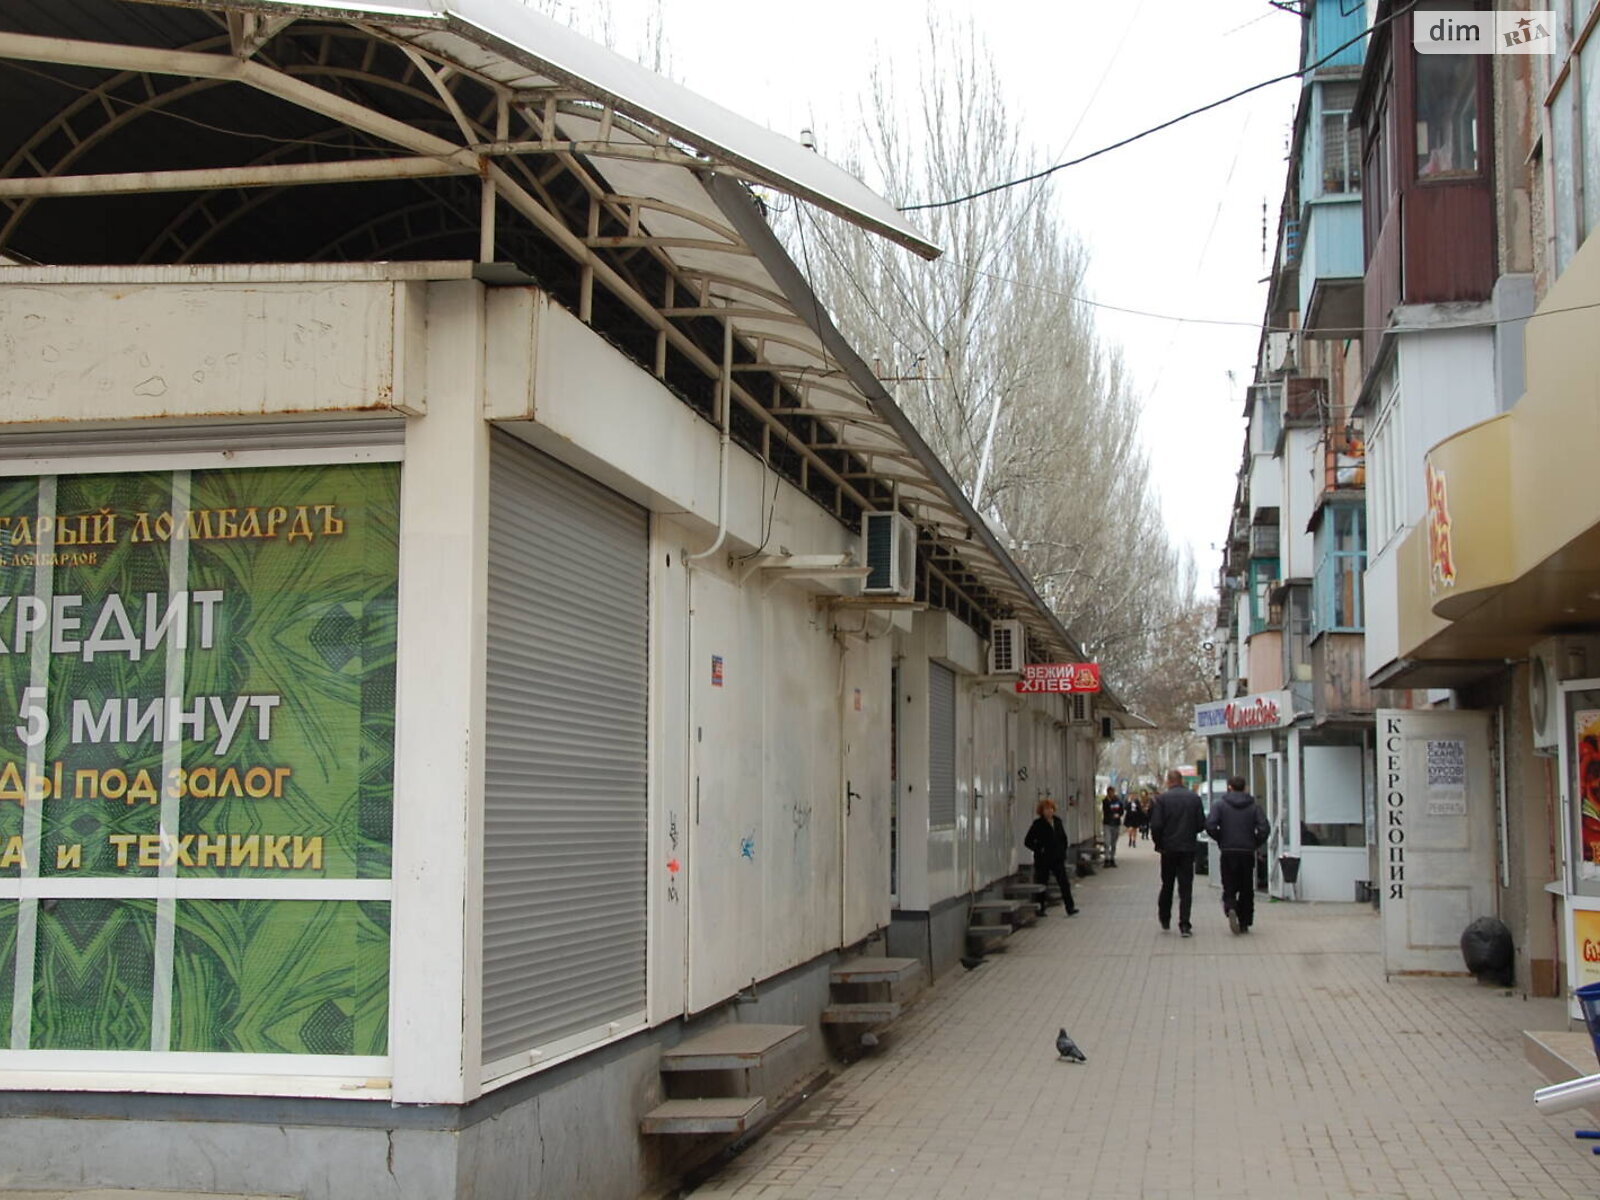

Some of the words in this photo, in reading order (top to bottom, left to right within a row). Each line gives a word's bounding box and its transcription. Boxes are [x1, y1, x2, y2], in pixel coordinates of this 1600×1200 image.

[131, 504, 344, 543] ЛОМБАРДЪ
[1021, 679, 1072, 691] ХЛЕБ
[1025, 664, 1075, 679] ВЕЖИЙ
[16, 686, 50, 746] 5
[75, 768, 157, 805] под
[167, 766, 292, 798] залог
[1387, 718, 1405, 899] КСЕРОКОПИЯ
[57, 843, 81, 869] и
[110, 834, 323, 870] ТЕХНИКИ
